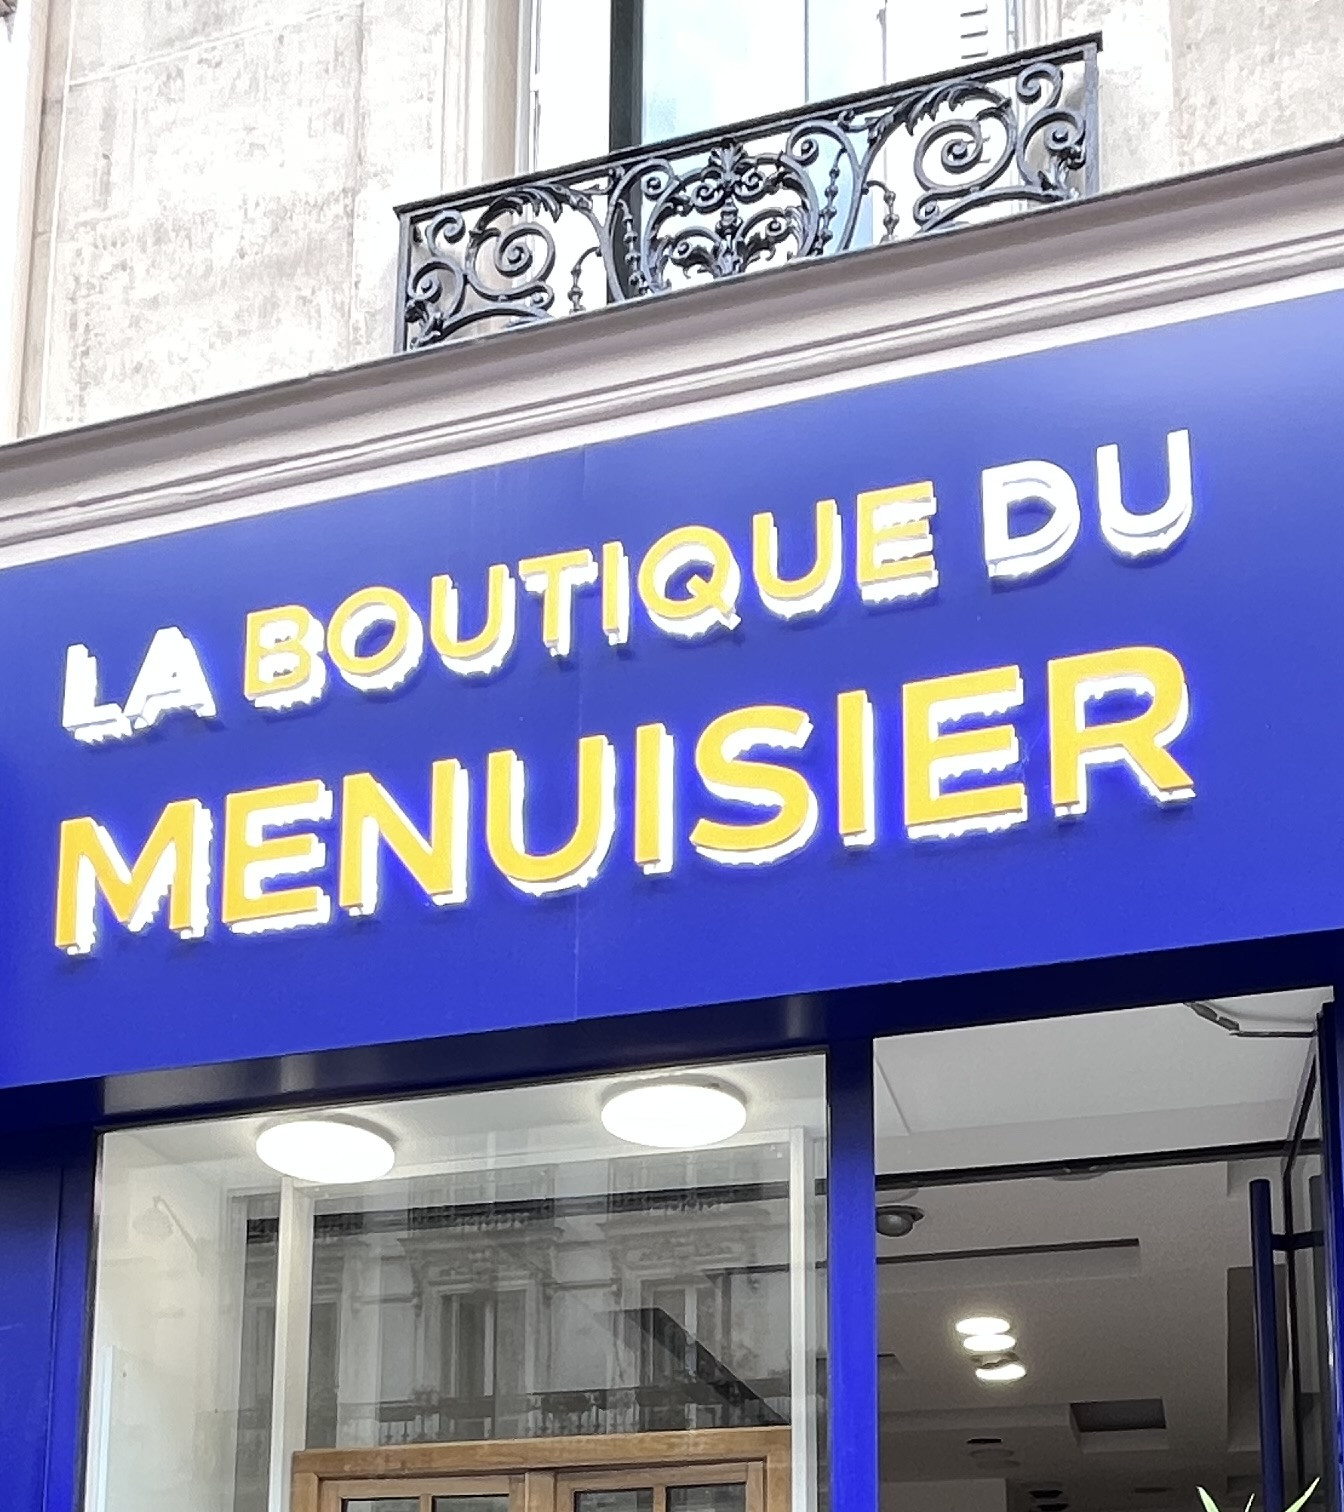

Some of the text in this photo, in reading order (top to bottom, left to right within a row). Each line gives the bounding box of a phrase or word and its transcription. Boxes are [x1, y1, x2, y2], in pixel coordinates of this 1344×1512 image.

[61, 428, 1195, 745] LA BOUTIQUE DU
[54, 645, 1197, 957] MENUISIER
